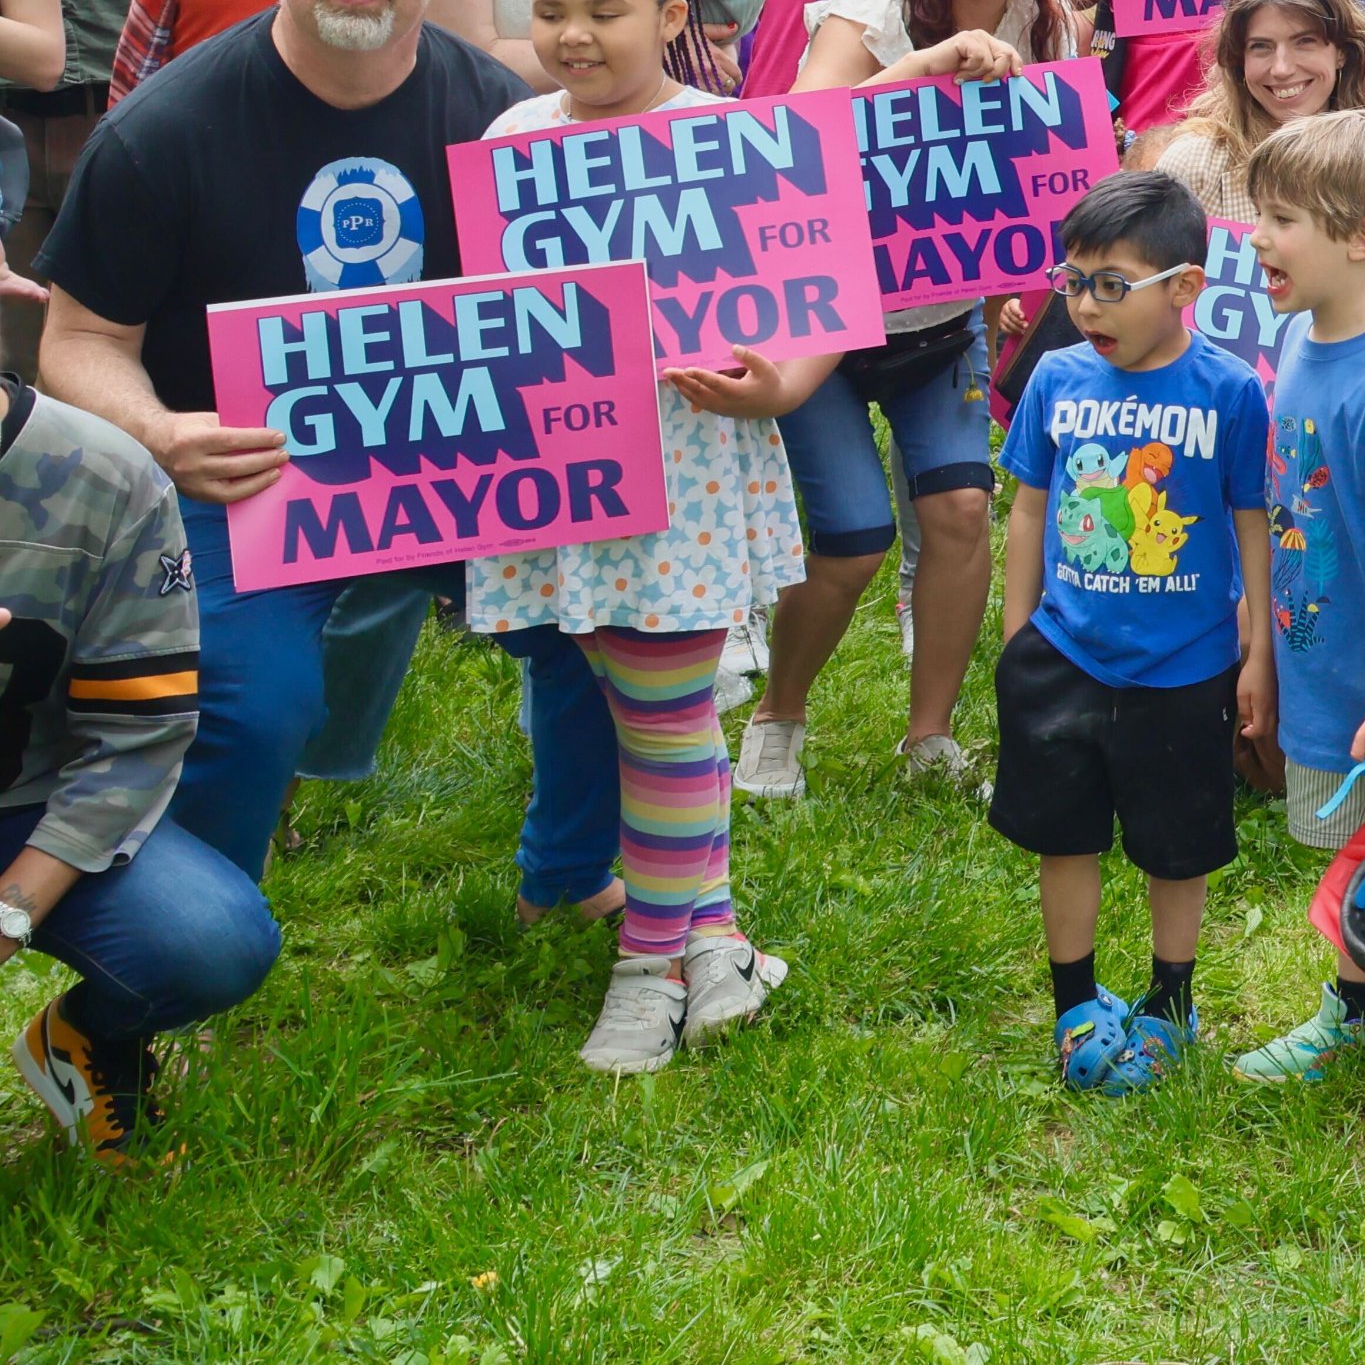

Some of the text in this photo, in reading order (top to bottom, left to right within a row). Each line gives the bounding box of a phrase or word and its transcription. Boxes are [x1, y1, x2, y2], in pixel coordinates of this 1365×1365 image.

[491, 105, 794, 212] HELEN
[860, 140, 1090, 211] YM FOR
[501, 186, 832, 273] GYM FOR
[258, 282, 581, 386] HELEN
[654, 274, 847, 360] YOR
[1194, 286, 1312, 347] GY
[265, 366, 618, 456] GYM FOR
[1051, 395, 1217, 460] POKÉMON
[283, 459, 630, 565] MAYOR
[1057, 563, 1080, 588] GOTTA
[1084, 573, 1129, 593] CATCH
[1135, 577, 1160, 593] 'EM
